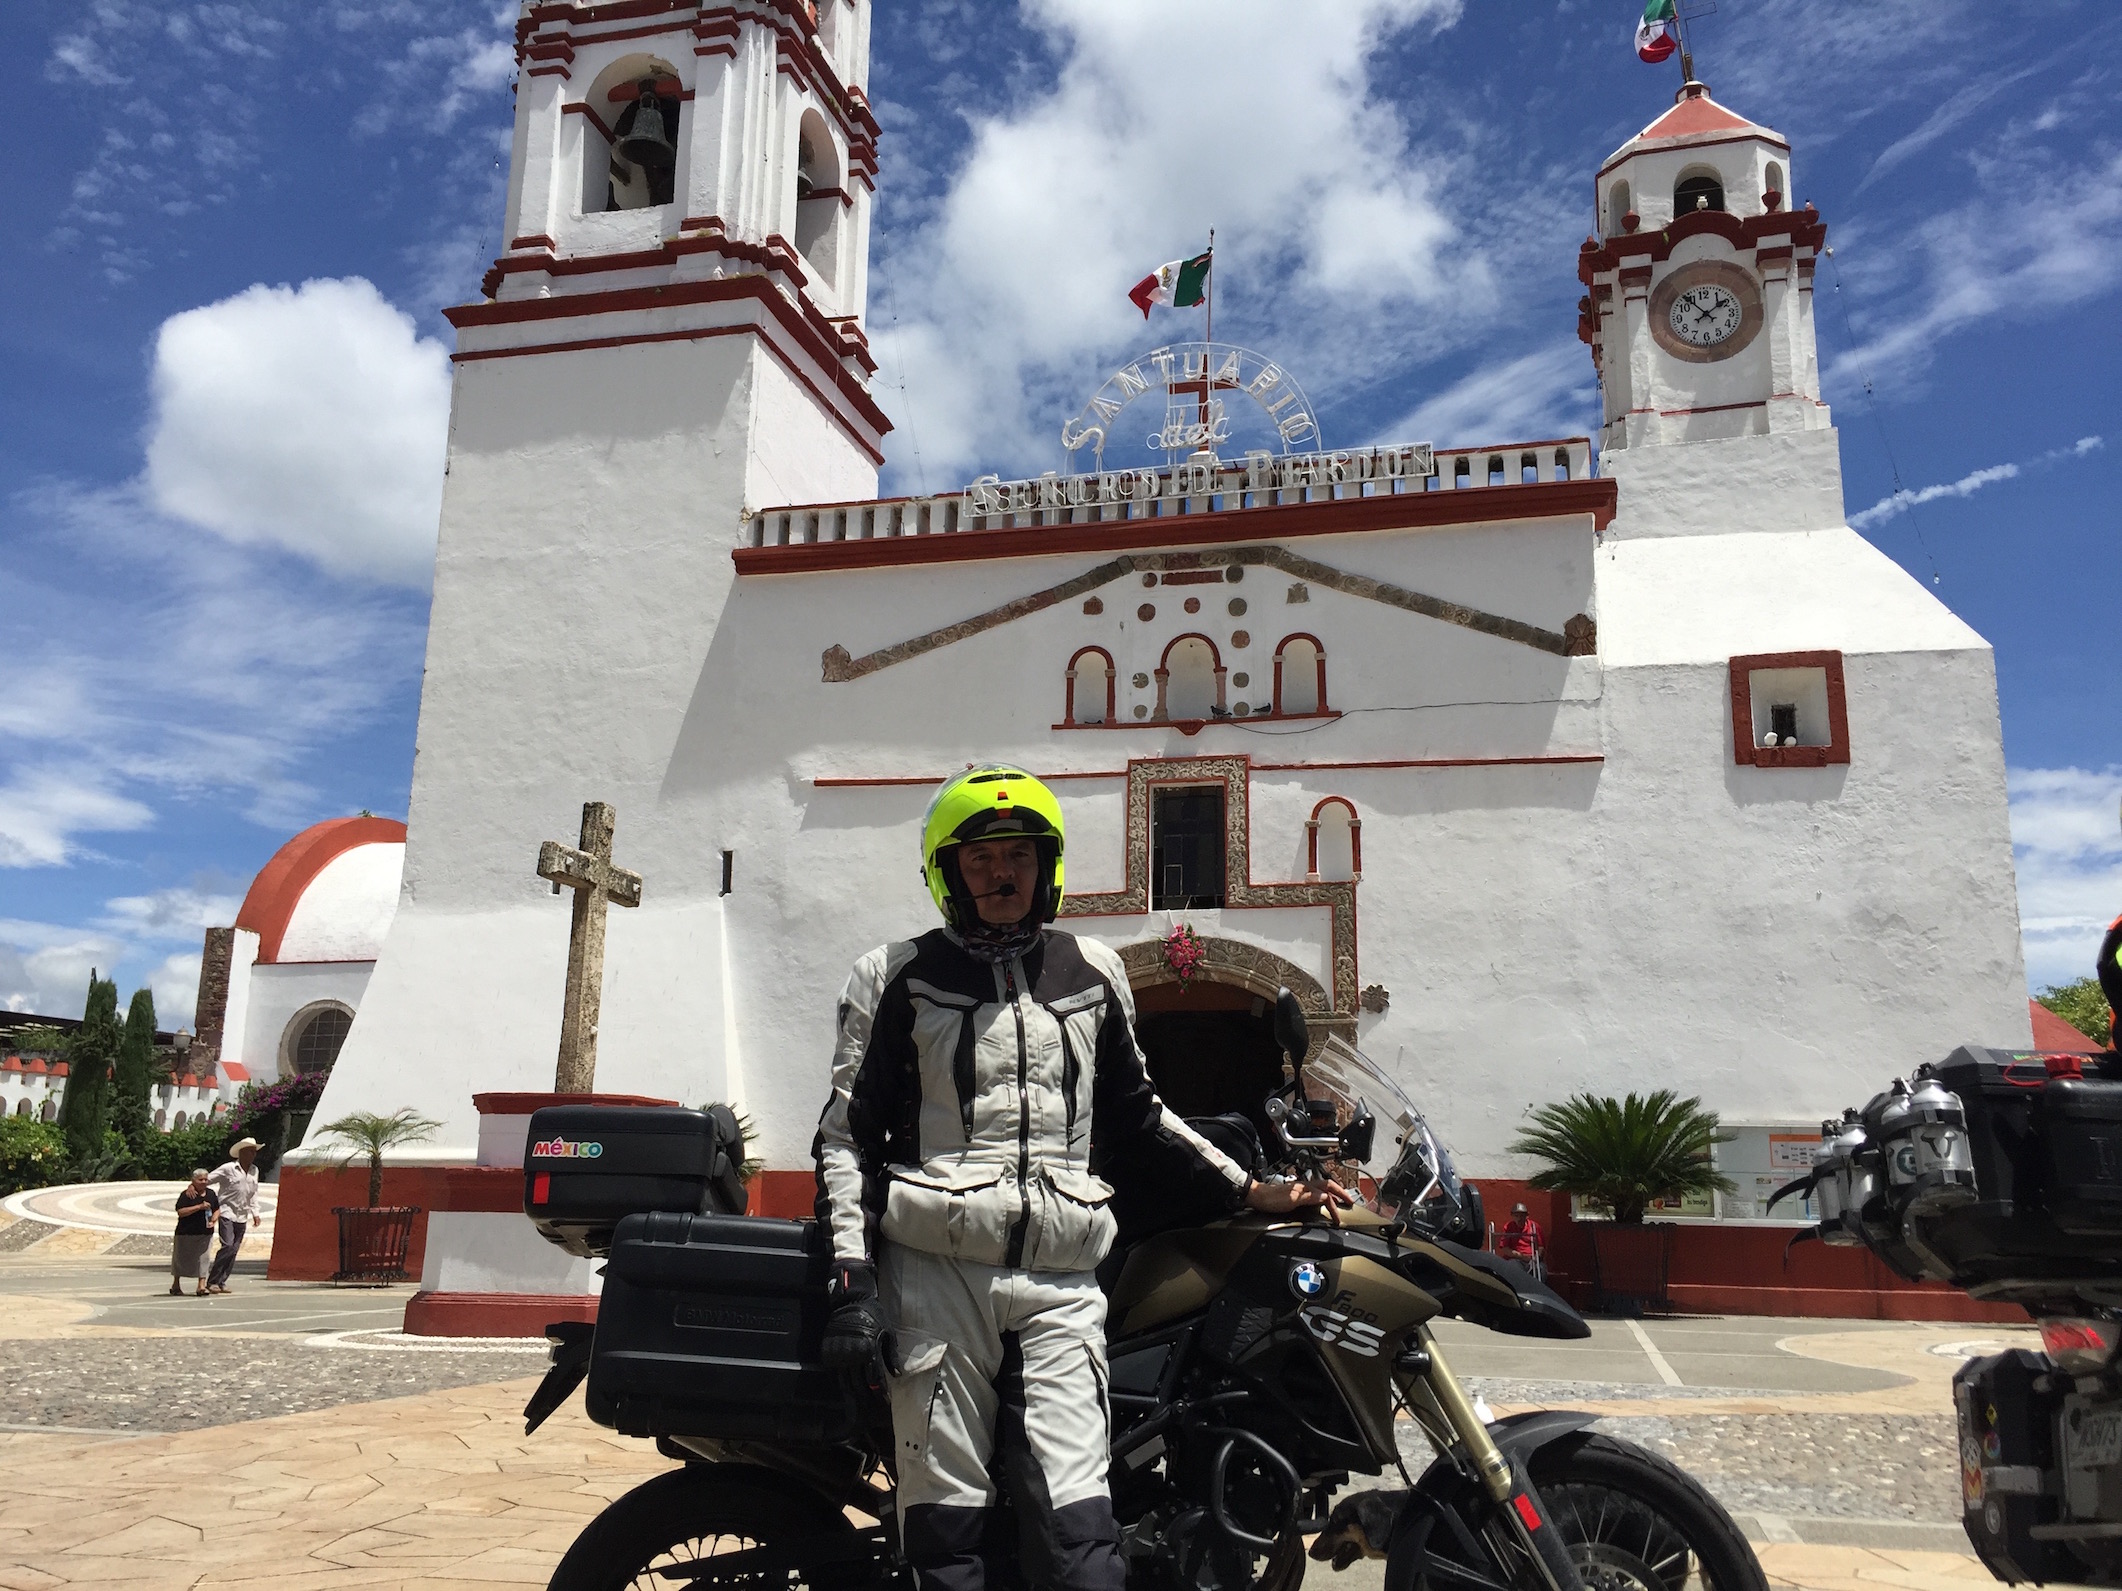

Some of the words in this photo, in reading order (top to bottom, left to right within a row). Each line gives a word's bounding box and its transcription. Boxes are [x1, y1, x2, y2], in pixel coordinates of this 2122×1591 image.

[1698, 290, 1709, 300] 12
[1714, 291, 1719, 303] 1
[1680, 303, 1690, 313] 10
[1728, 307, 1735, 318] 3
[1675, 313, 1683, 324] 9
[1724, 318, 1732, 329] 4
[1681, 323, 1689, 333] 8
[1714, 327, 1722, 337] 5
[1691, 330, 1699, 340] 7
[1703, 331, 1711, 342] 6
[1061, 346, 1316, 454] SANTUARIO
[1331, 1289, 1357, 1306] F
[1337, 1303, 1378, 1323] 800
[1300, 1306, 1386, 1357] GS
